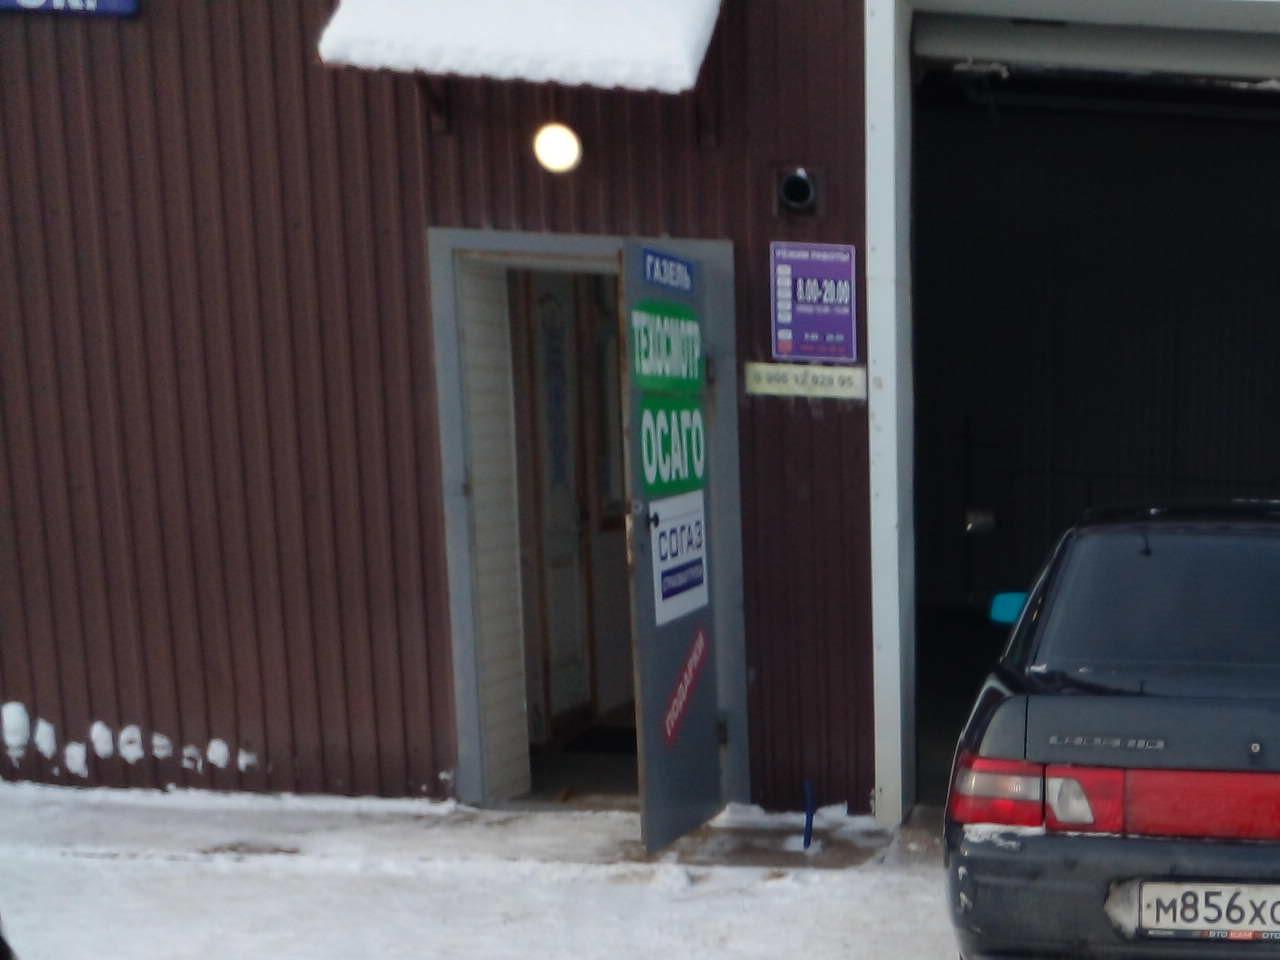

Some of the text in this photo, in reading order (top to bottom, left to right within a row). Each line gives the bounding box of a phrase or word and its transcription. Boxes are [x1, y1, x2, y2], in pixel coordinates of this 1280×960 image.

[646, 254, 691, 290] ГАЗЕЛЬ
[631, 310, 700, 379] ТЕХОСМОТР
[642, 408, 705, 484] ОСАГО
[659, 520, 702, 561] СОГАЗ
